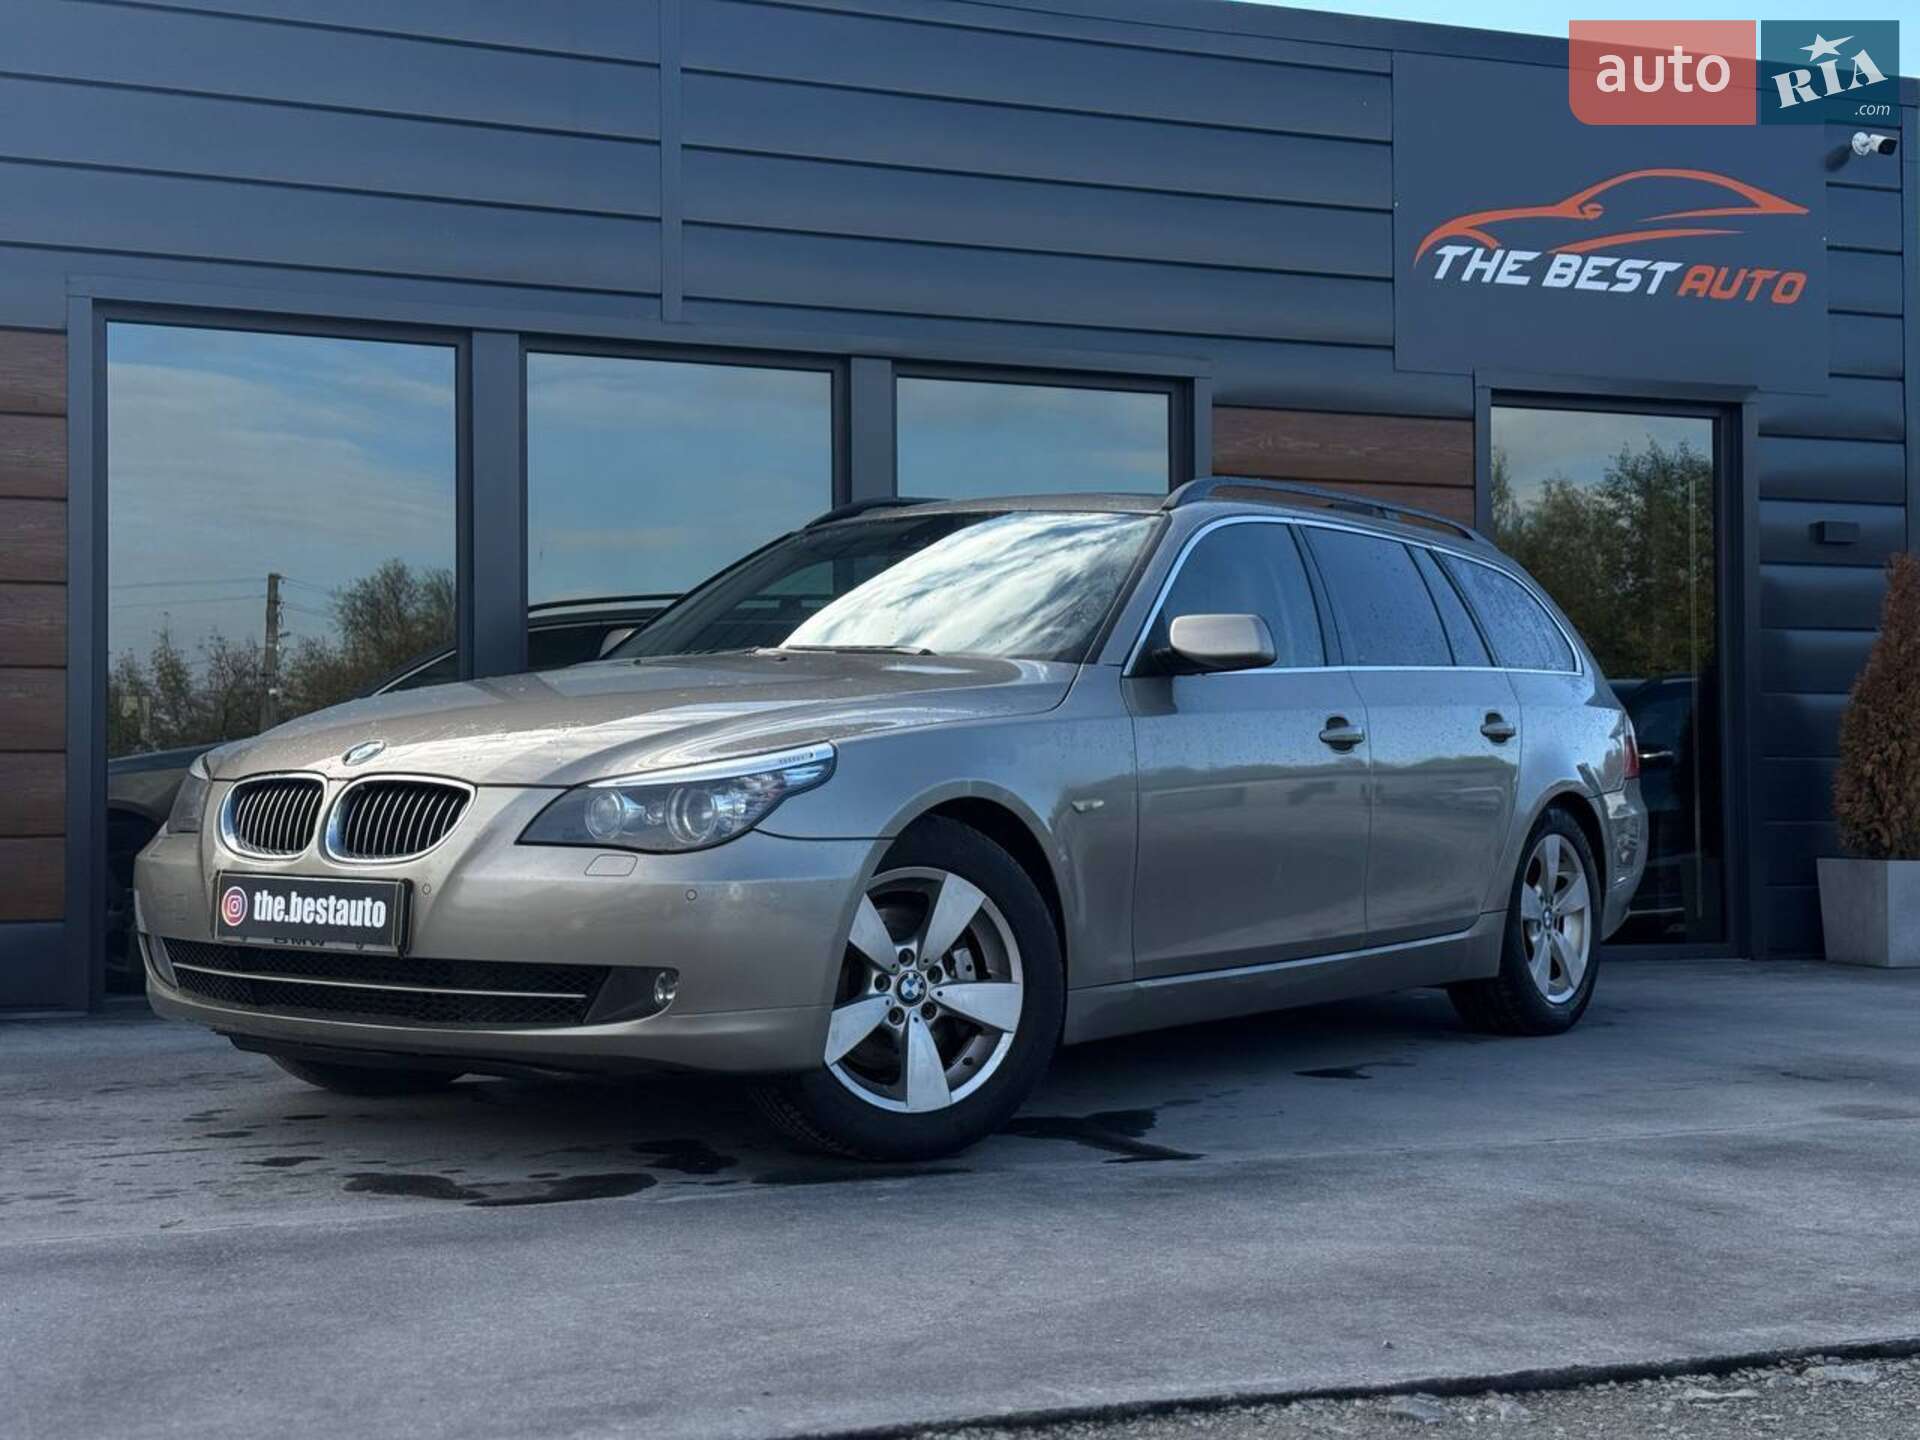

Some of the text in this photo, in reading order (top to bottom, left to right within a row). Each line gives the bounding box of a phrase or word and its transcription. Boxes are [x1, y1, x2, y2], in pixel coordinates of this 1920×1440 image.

[1434, 245, 1807, 305] THE BEST AUTO
[254, 890, 386, 928] the.bestauto
